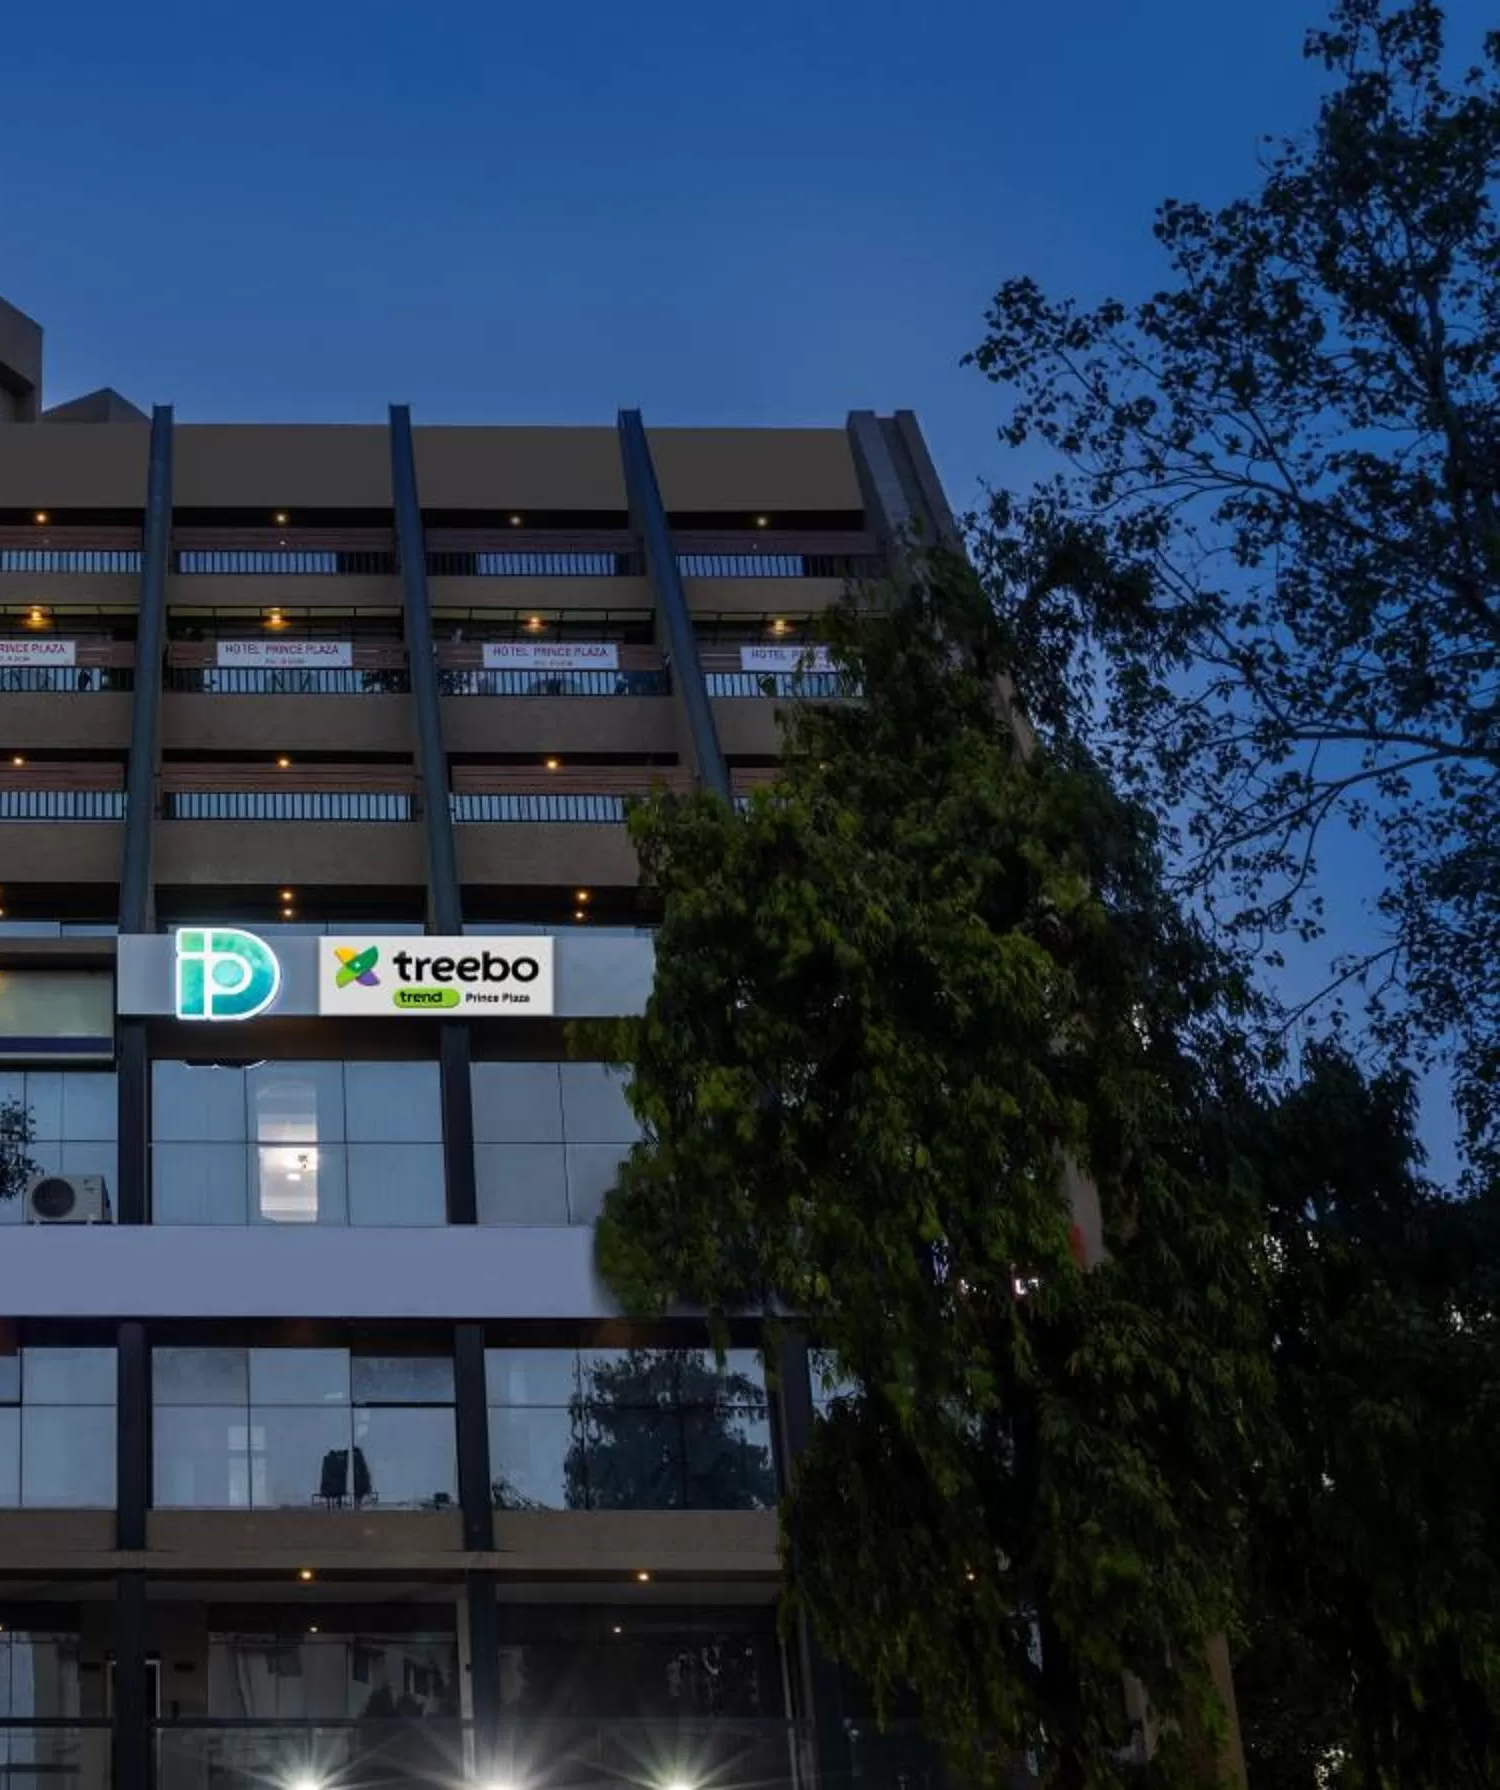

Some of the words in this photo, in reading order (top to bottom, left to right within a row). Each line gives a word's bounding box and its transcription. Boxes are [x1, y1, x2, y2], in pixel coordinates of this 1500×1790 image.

[31, 643, 66, 653] PLAZA
[225, 644, 261, 655] HOTEL
[265, 644, 305, 655] PRINCE
[306, 644, 340, 655] PLAZA
[493, 647, 530, 657] HOTEL
[534, 647, 573, 657] PRINCE
[574, 647, 609, 657] PLAZA
[393, 951, 539, 982] treebo
[400, 991, 442, 1003] trend
[465, 992, 499, 1003] Prince
[502, 992, 531, 1003] Plaza
